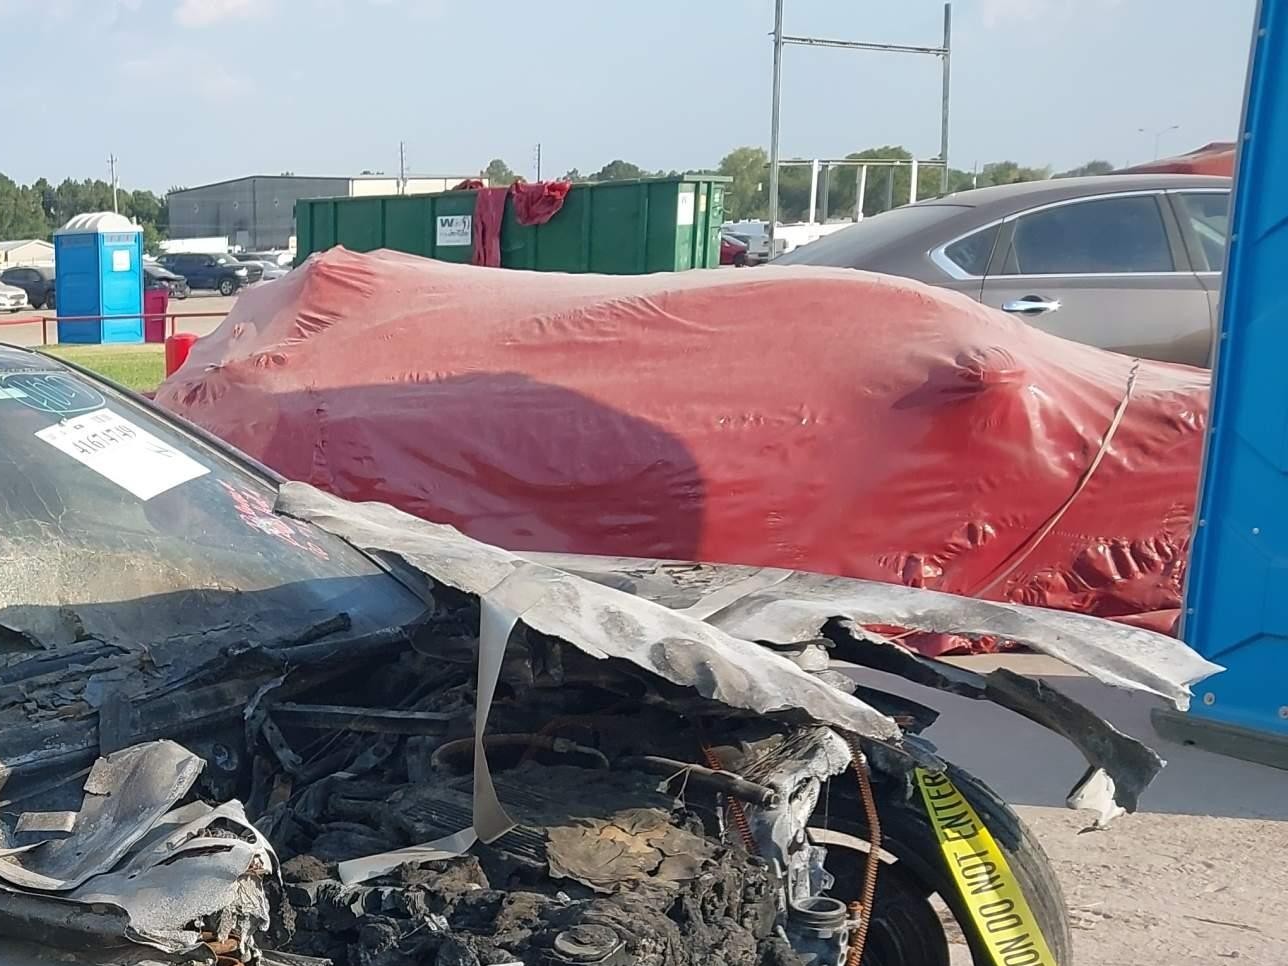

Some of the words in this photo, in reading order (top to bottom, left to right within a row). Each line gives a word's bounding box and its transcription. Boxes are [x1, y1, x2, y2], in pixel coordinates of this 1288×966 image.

[922, 773, 979, 842] ENTER
[953, 849, 1005, 895] NOT
[978, 898, 1023, 934] DO
